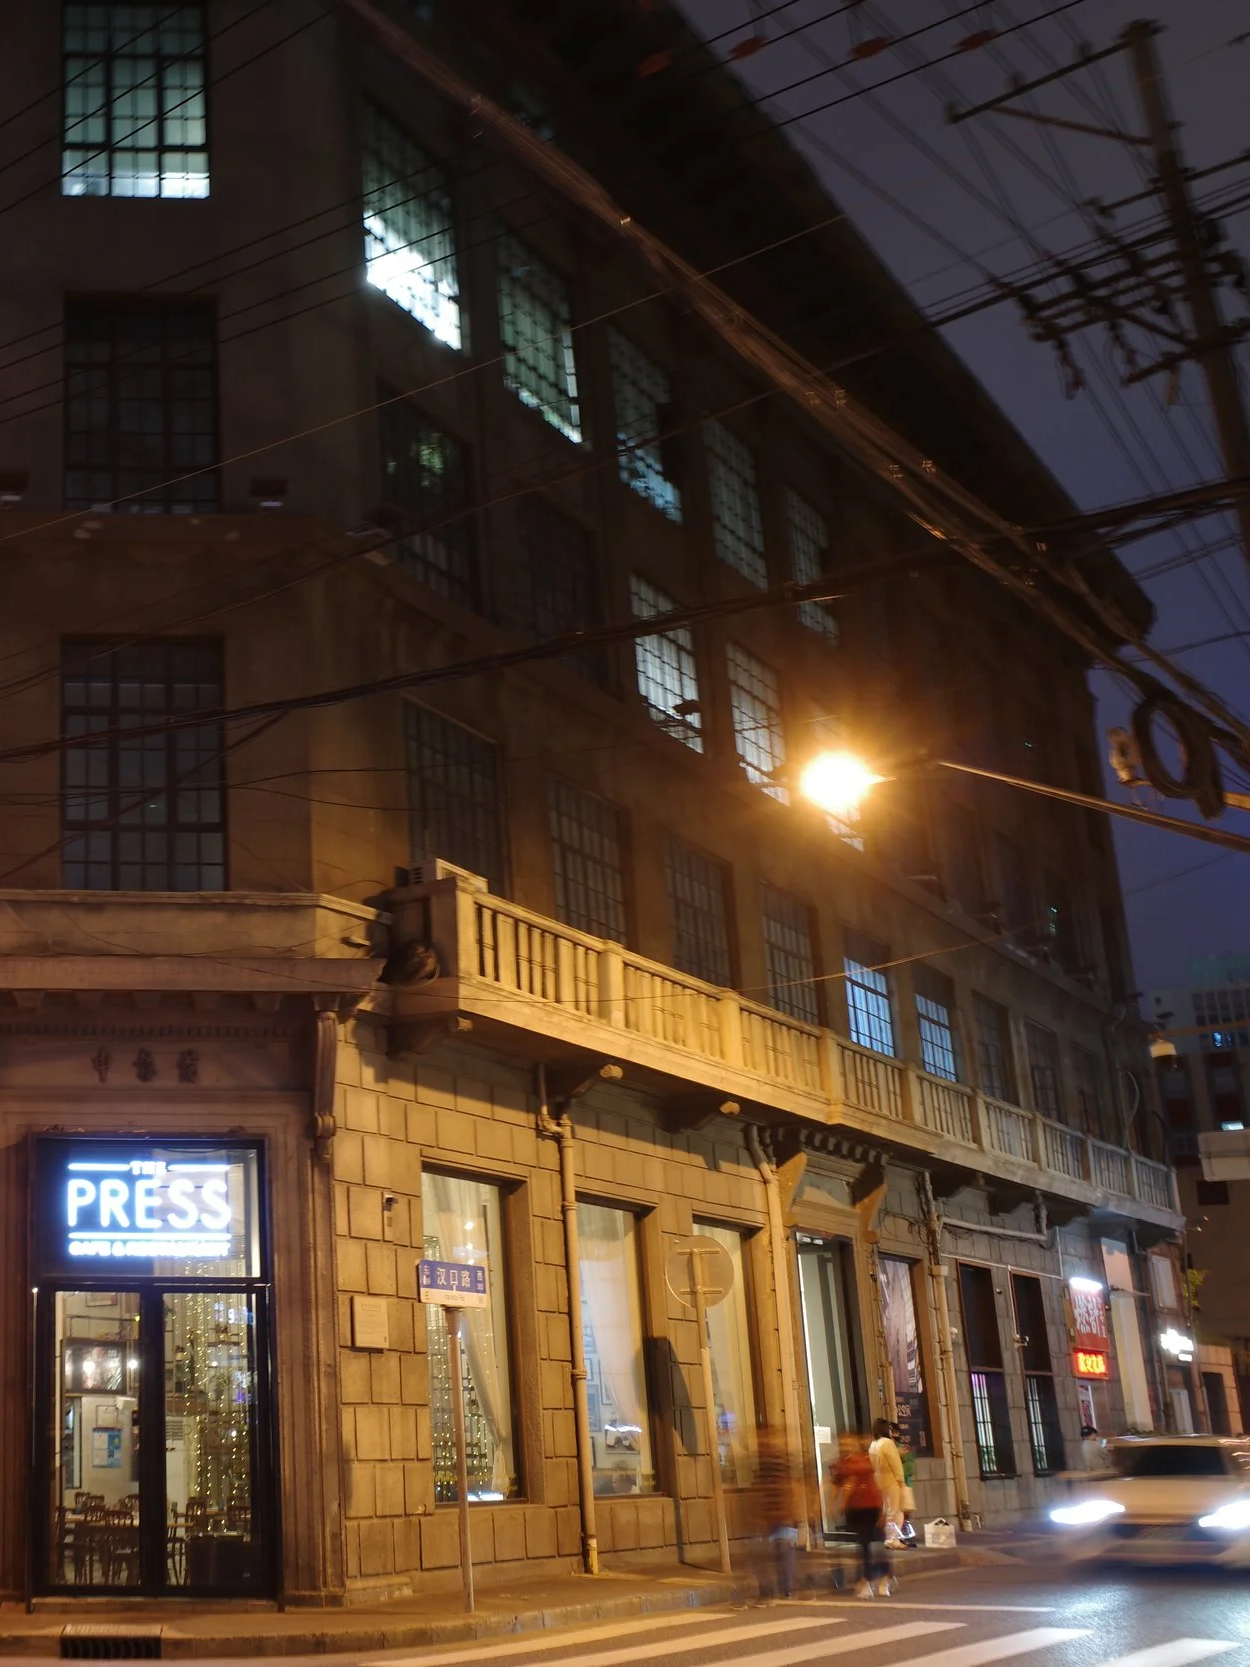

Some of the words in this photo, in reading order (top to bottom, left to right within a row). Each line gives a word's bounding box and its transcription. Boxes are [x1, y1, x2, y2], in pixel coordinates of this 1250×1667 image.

[129, 1160, 167, 1175] THE
[67, 1178, 233, 1230] PRESS
[436, 1266, 471, 1289] 汉口路
